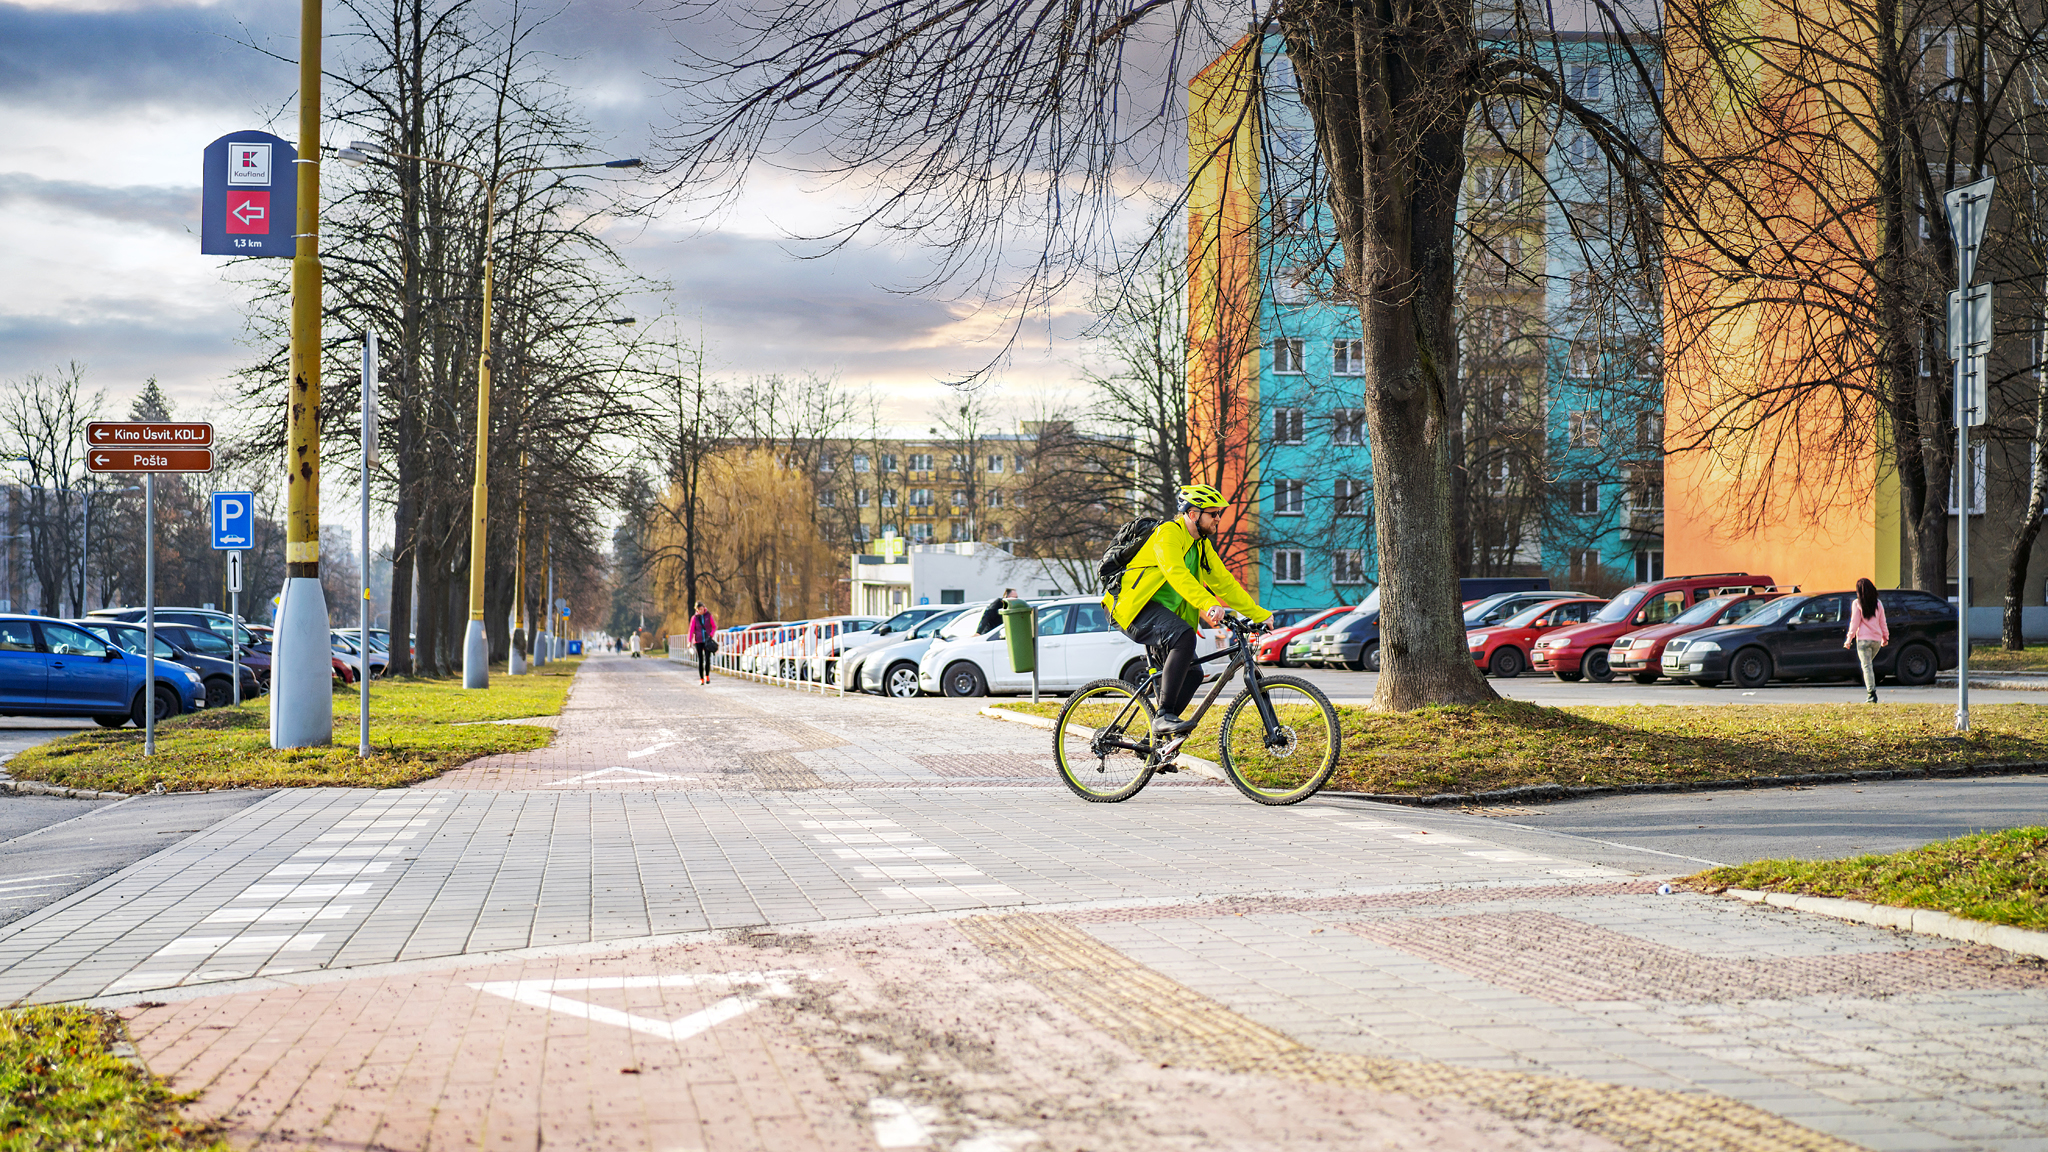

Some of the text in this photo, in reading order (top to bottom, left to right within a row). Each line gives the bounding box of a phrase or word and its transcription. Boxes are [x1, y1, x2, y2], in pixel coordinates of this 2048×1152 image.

[234, 238, 262, 248] 1,3 km
[114, 429, 140, 440] Kino
[174, 429, 205, 440] KDLJ
[133, 454, 168, 466] Pošta
[221, 499, 244, 532] P
